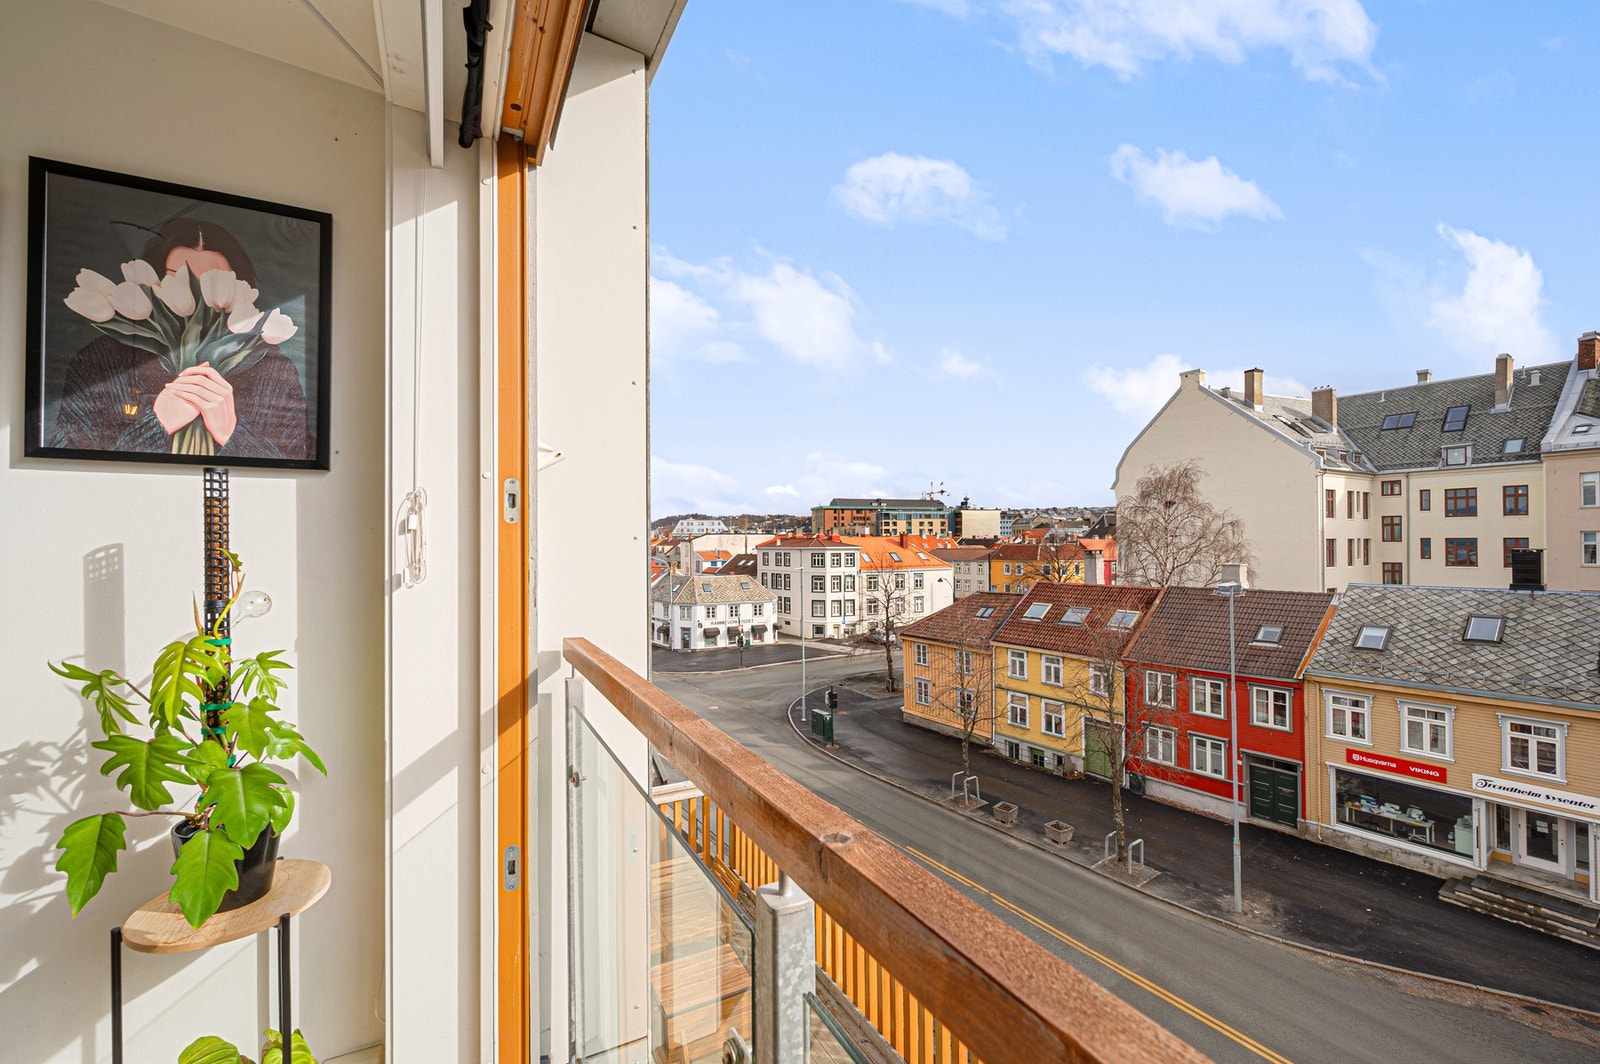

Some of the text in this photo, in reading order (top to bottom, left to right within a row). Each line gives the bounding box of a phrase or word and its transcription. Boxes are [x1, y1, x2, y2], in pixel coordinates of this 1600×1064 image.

[1359, 756, 1439, 777] Husqvarna VIKING
[1475, 778, 1597, 809] Trondheim Sysenter
